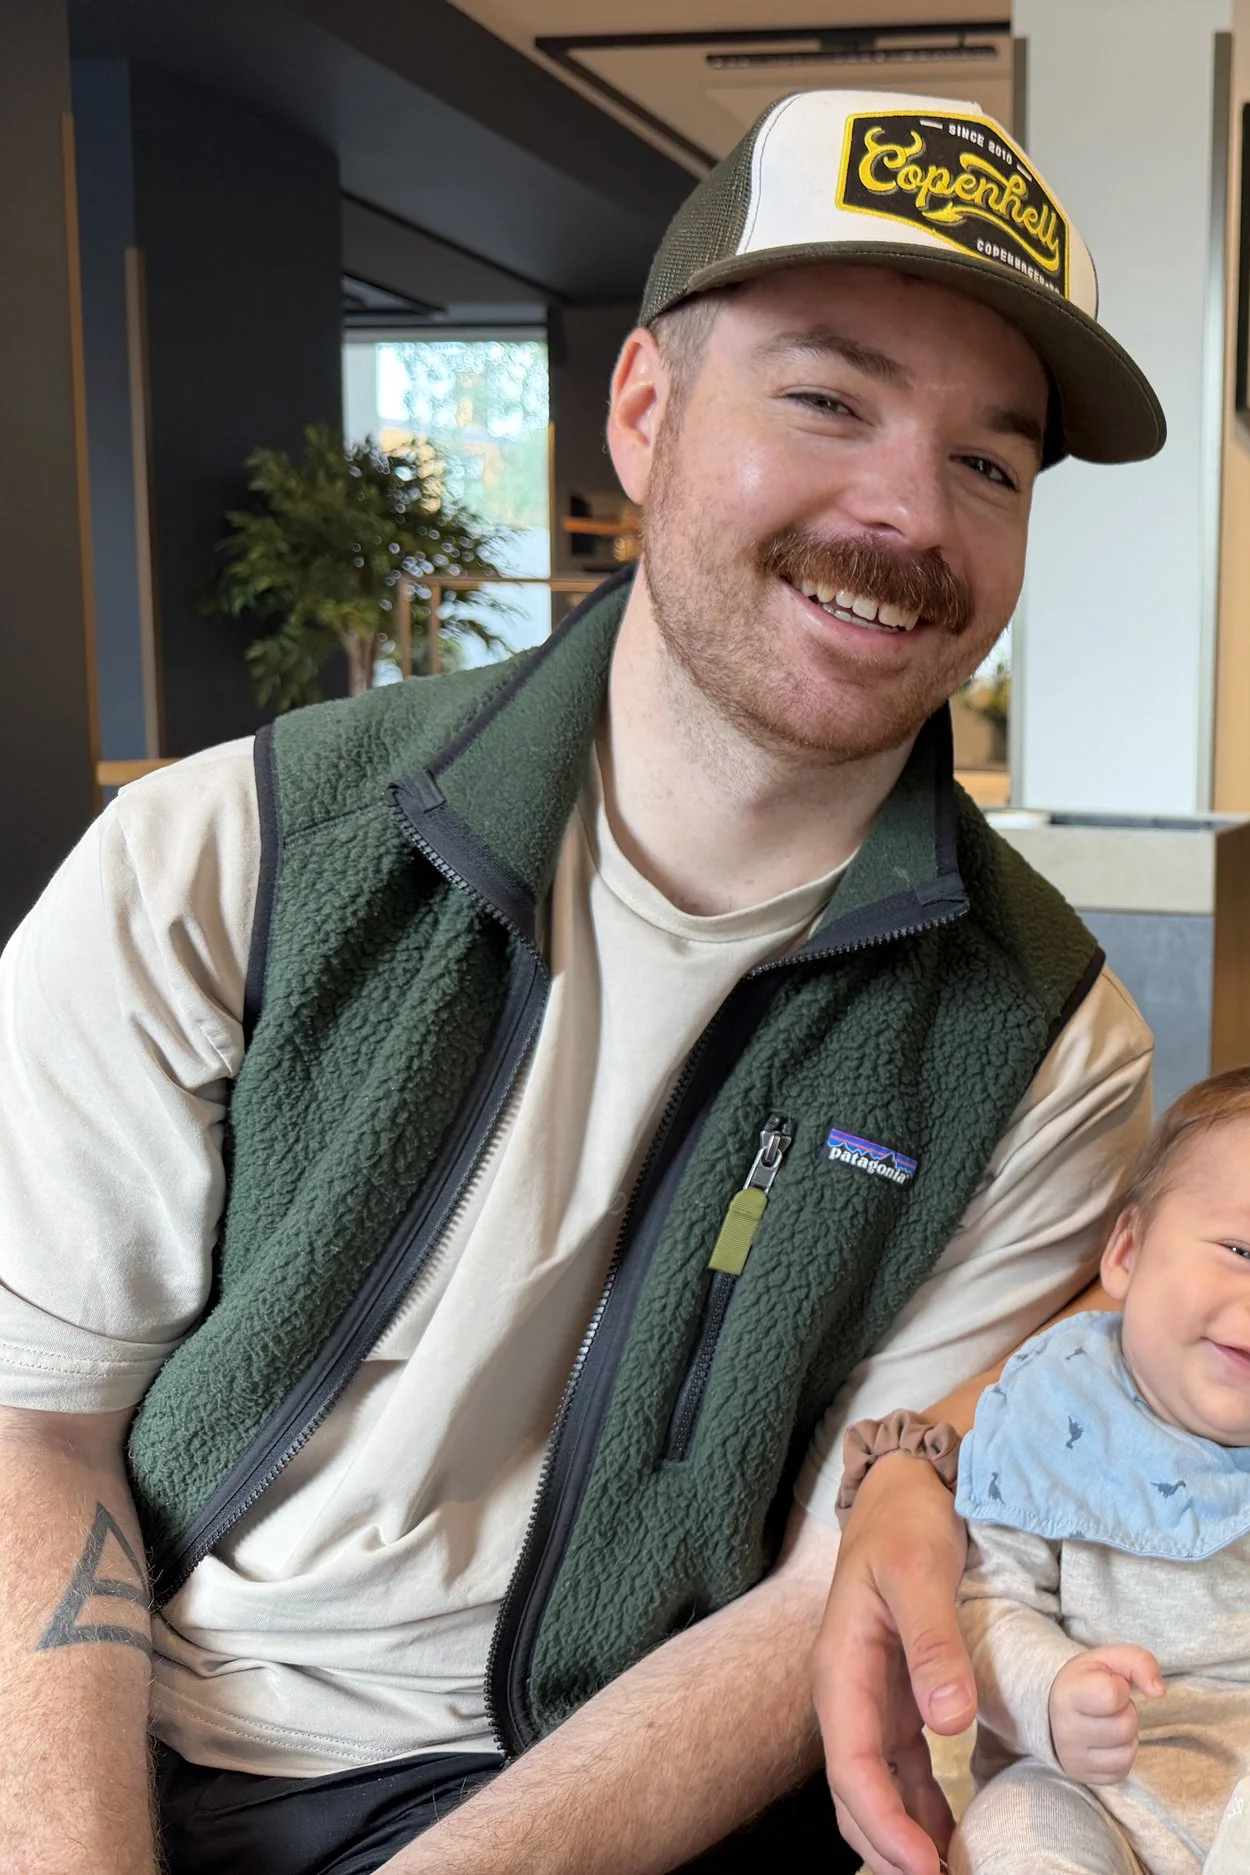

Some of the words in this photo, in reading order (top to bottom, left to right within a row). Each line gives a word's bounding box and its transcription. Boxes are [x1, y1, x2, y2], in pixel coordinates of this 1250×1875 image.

[948, 123, 985, 148] SINCE
[988, 140, 1013, 166] 2010
[858, 126, 1060, 251] Copenhell
[828, 1146, 907, 1185] patagonia
